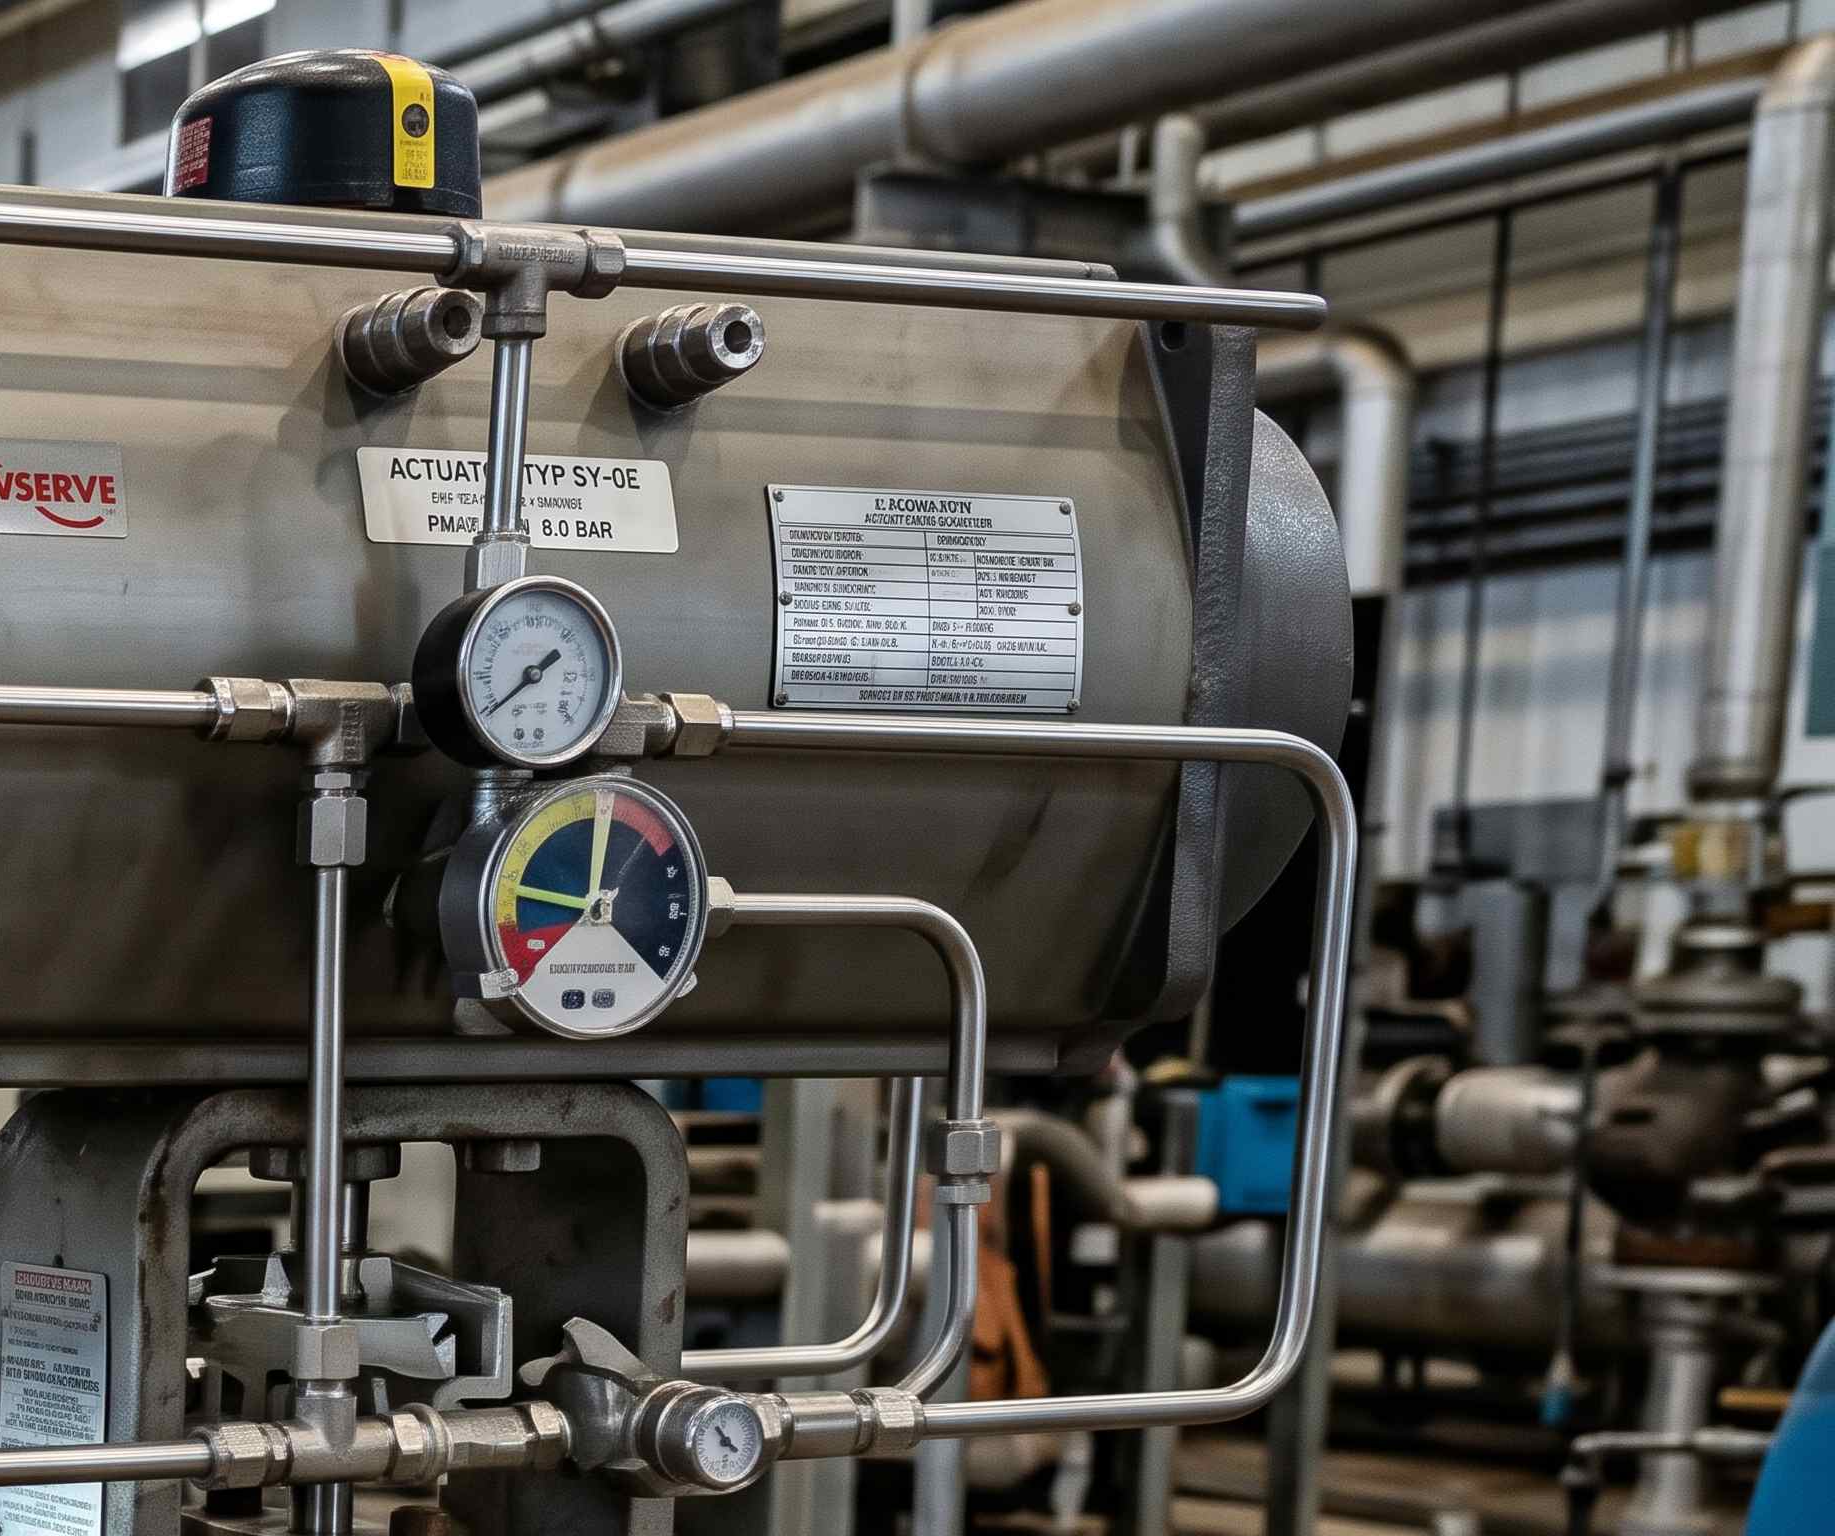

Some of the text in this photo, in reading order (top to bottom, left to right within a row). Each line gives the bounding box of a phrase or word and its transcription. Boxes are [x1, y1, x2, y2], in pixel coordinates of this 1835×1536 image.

[389, 457, 489, 483] ACTUAT
[525, 463, 566, 486] TYP
[541, 519, 569, 538] 8.0
[576, 520, 613, 540] BAR
